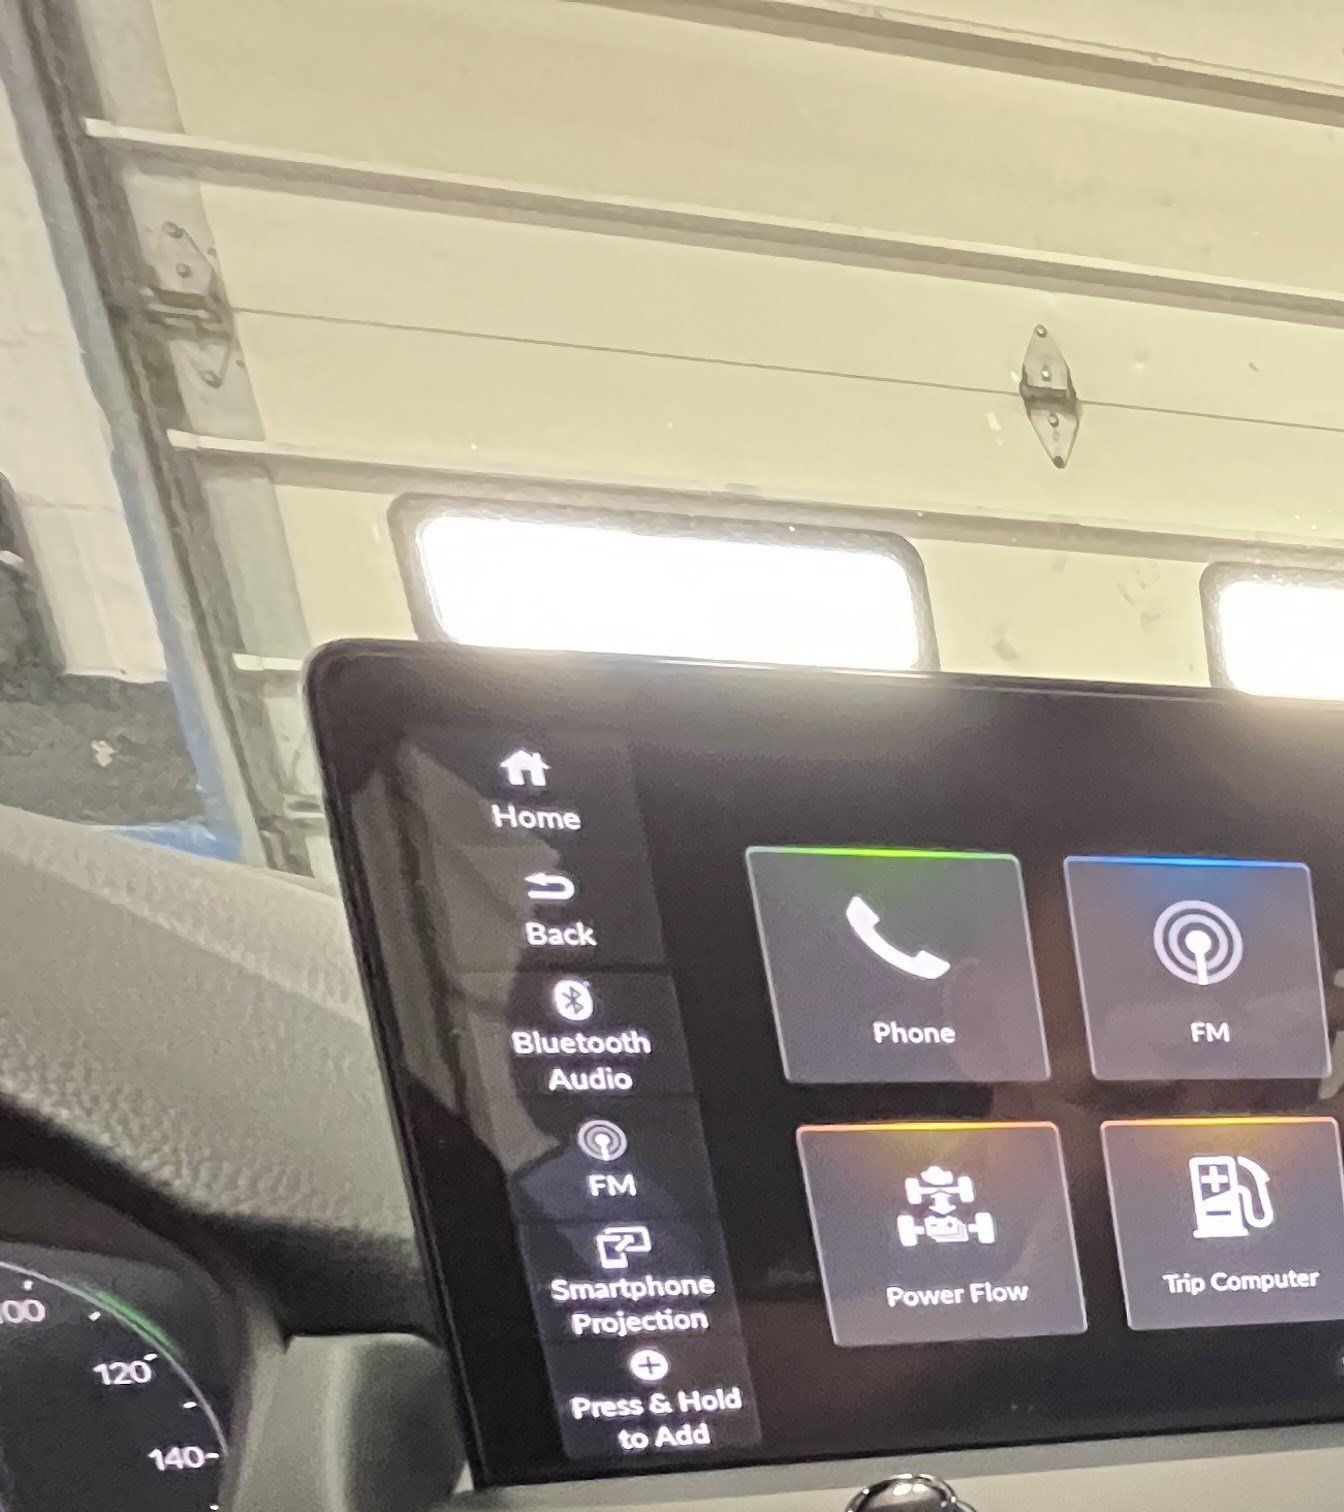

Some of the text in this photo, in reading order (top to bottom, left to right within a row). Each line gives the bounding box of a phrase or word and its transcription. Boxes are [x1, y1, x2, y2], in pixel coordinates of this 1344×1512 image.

[491, 805, 581, 831] Home
[526, 923, 597, 947] Back
[512, 1031, 651, 1056] Bluetooth
[873, 1021, 956, 1045] Phone
[1190, 1022, 1231, 1043] FM
[548, 1067, 633, 1092] Audio
[587, 1174, 636, 1198] FM
[551, 1275, 716, 1303] Smartphone
[886, 1281, 1030, 1309] Power Flow
[1162, 1268, 1320, 1298] Trip Computer
[0, 1299, 46, 1324] 00
[571, 1308, 709, 1337] Projection
[93, 1360, 153, 1386] 120
[570, 1388, 743, 1420] Press & Hold
[618, 1424, 711, 1451] to Add
[147, 1446, 206, 1472] 140
